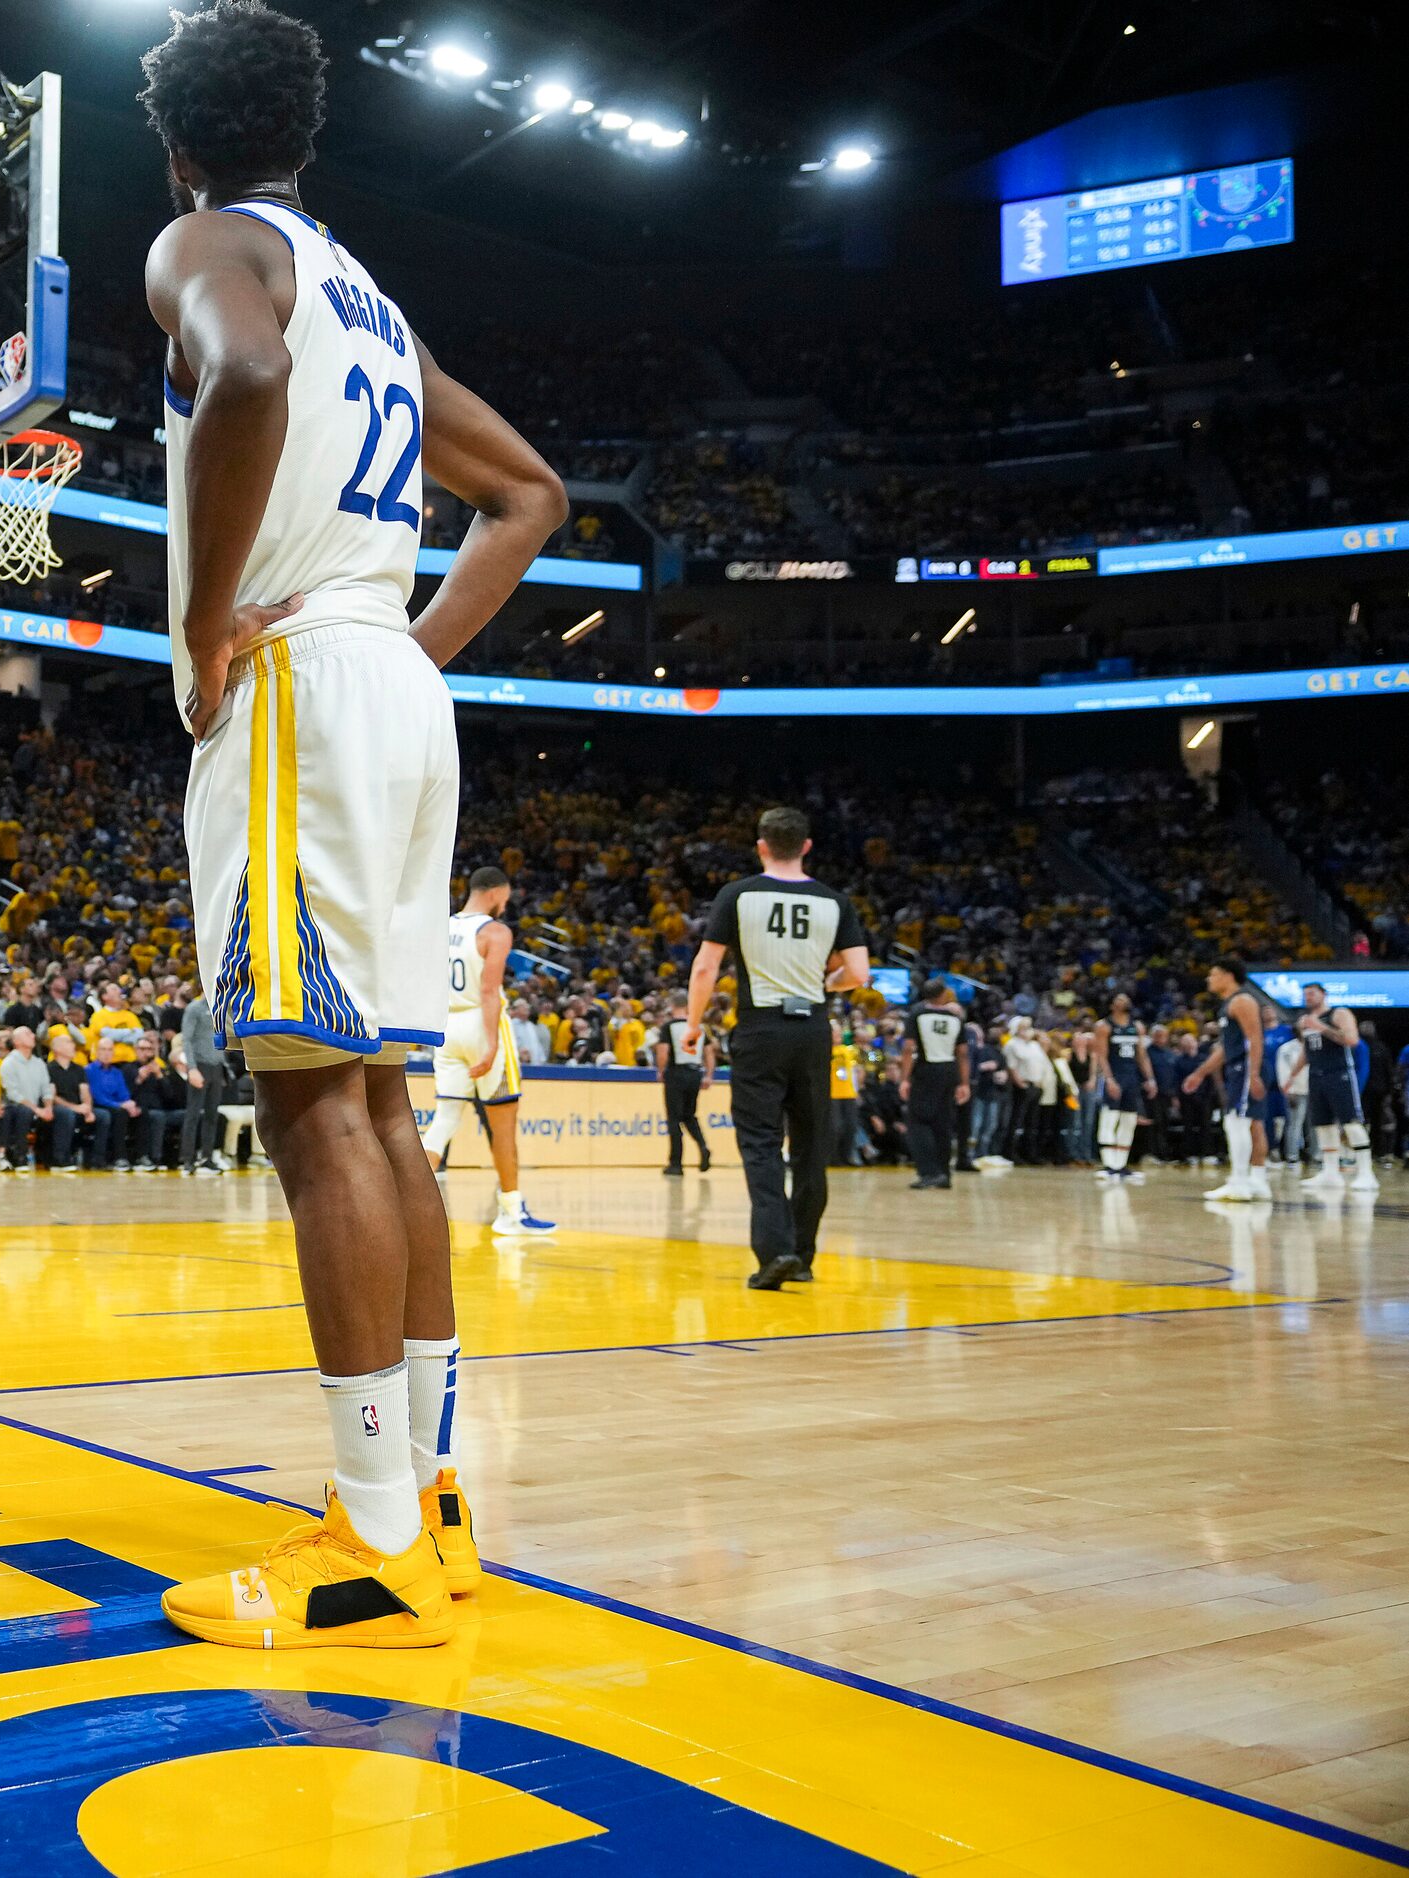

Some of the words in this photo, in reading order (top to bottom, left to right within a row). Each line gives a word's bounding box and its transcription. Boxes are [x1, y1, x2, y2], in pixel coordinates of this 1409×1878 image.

[320, 275, 406, 357] WIGGINS
[339, 363, 422, 533] 22
[1343, 528, 1397, 550] GET
[594, 688, 631, 707] GET
[1307, 672, 1360, 694] GET
[766, 901, 811, 940] 46
[520, 1117, 563, 1142] way
[569, 1112, 584, 1135] it
[588, 1113, 652, 1137] should
